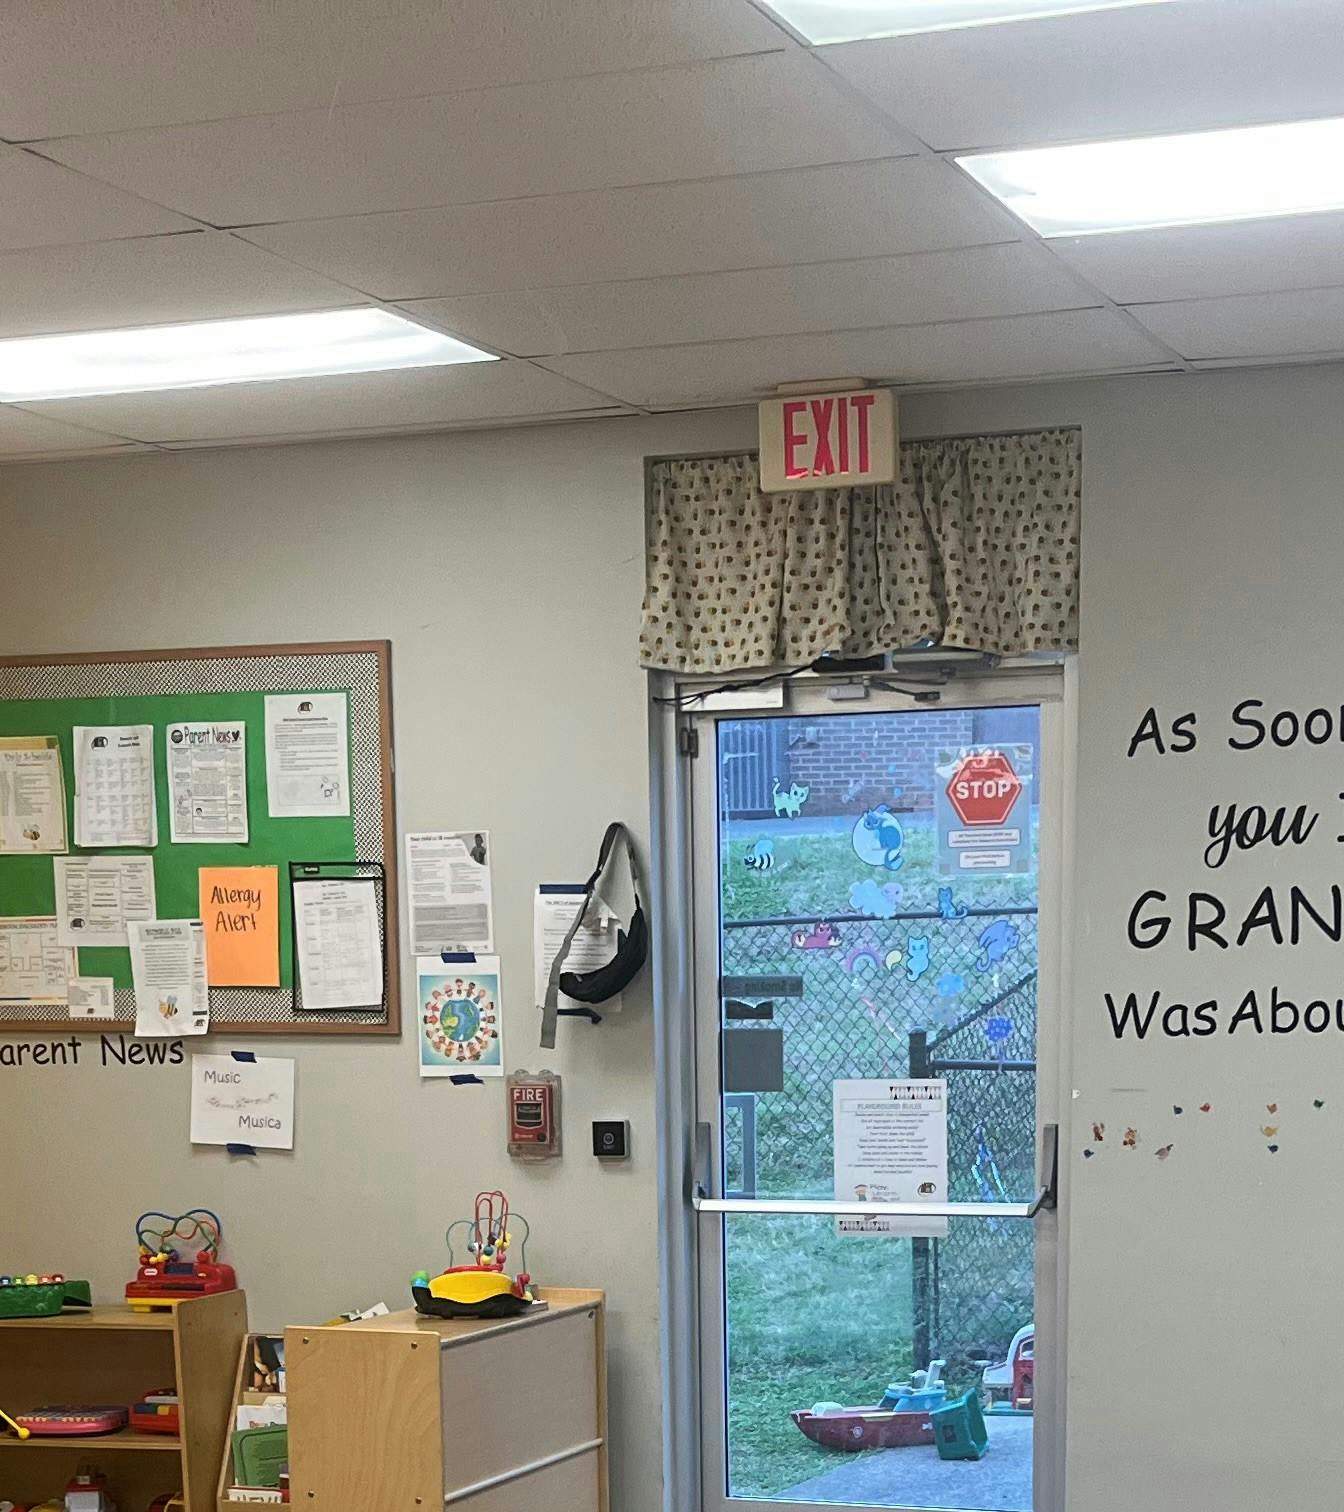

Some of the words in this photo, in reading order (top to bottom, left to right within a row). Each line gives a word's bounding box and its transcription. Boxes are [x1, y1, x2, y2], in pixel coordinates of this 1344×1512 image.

[783, 395, 875, 480] EXIT
[184, 726, 210, 744] Parent
[1128, 707, 1197, 757] As
[956, 780, 1011, 799] STOP
[1203, 803, 1320, 868] you
[211, 885, 261, 912] Allergy
[1105, 991, 1218, 1040] Was
[100, 1034, 184, 1066] News
[204, 1070, 242, 1084] Music
[513, 1089, 544, 1101] FIRE
[238, 1115, 282, 1130] Musica
